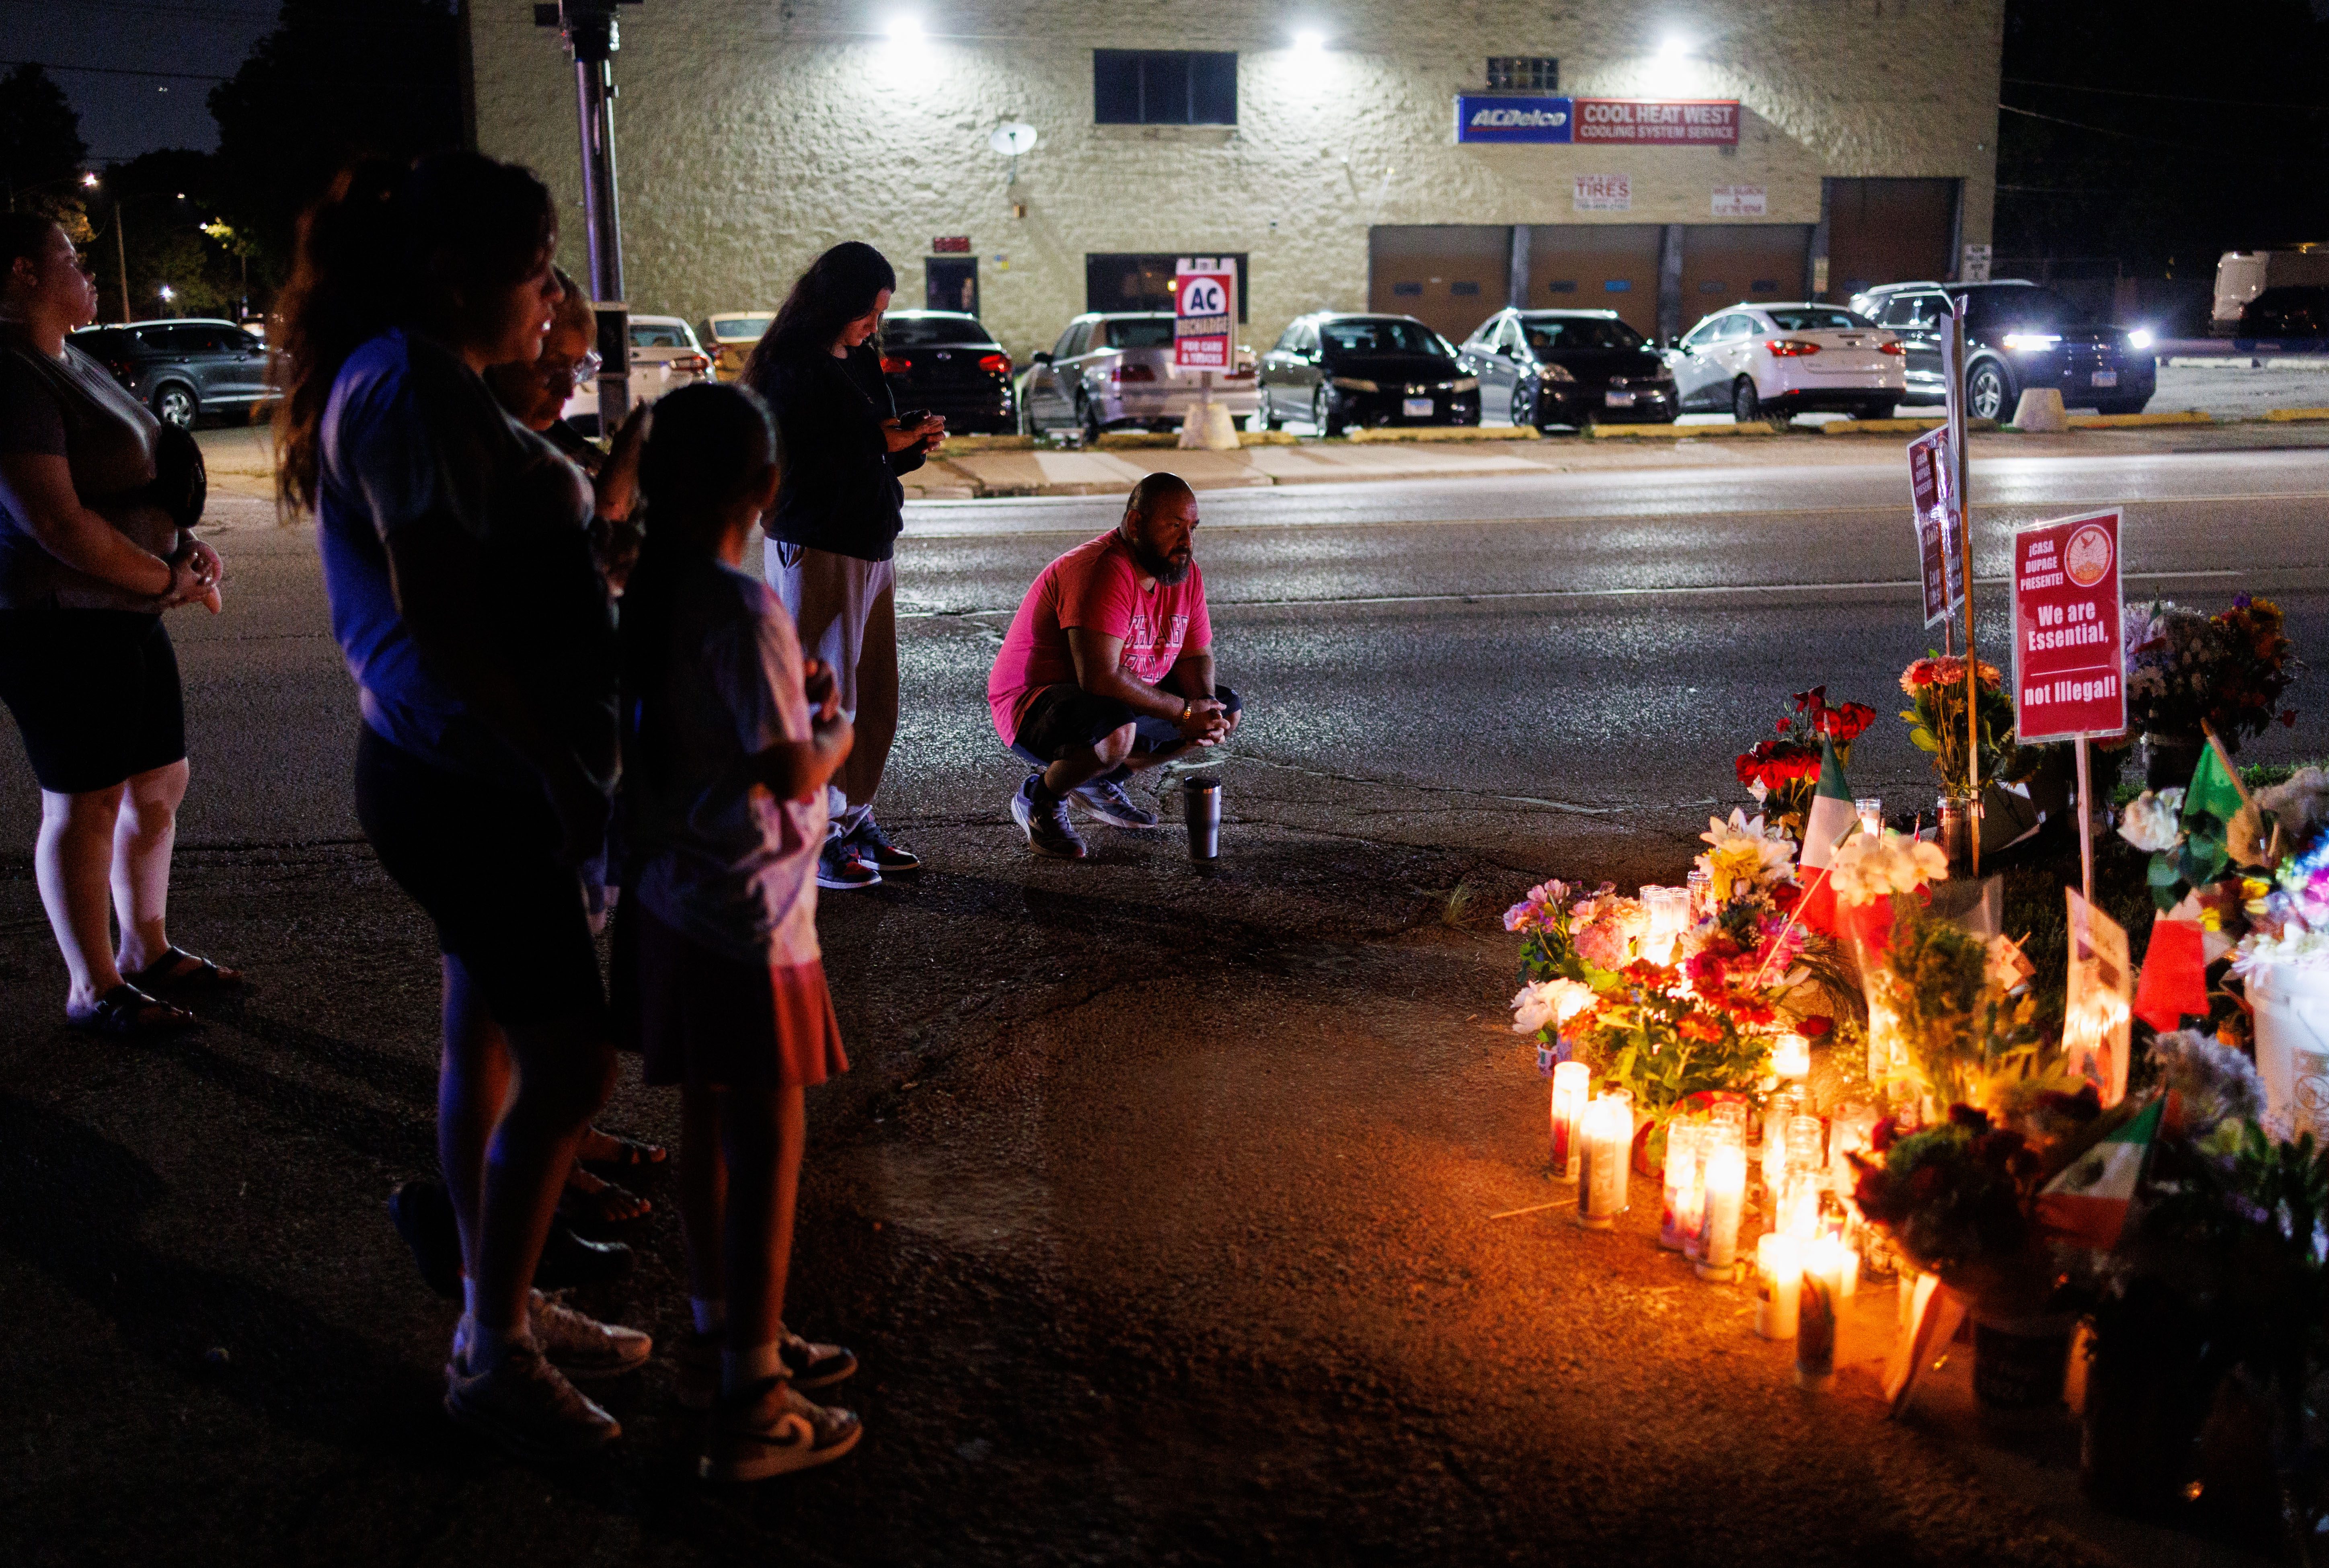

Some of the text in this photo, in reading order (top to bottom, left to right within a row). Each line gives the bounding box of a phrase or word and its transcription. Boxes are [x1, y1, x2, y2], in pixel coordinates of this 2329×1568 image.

[1471, 109, 1566, 127] ACDelco
[1584, 105, 1733, 124] COOL HEAT WEST
[1580, 125, 1734, 139] COOLING SYSTEM SERVICE
[1577, 183, 1629, 197] TIRES
[1190, 287, 1218, 311] AC
[2025, 556, 2058, 574] DUPAGE
[2020, 572, 2064, 591] PRESENTE!
[2037, 602, 2096, 627] We are
[2028, 621, 2109, 652] Essential,
[2024, 675, 2116, 706] not Illegal!
